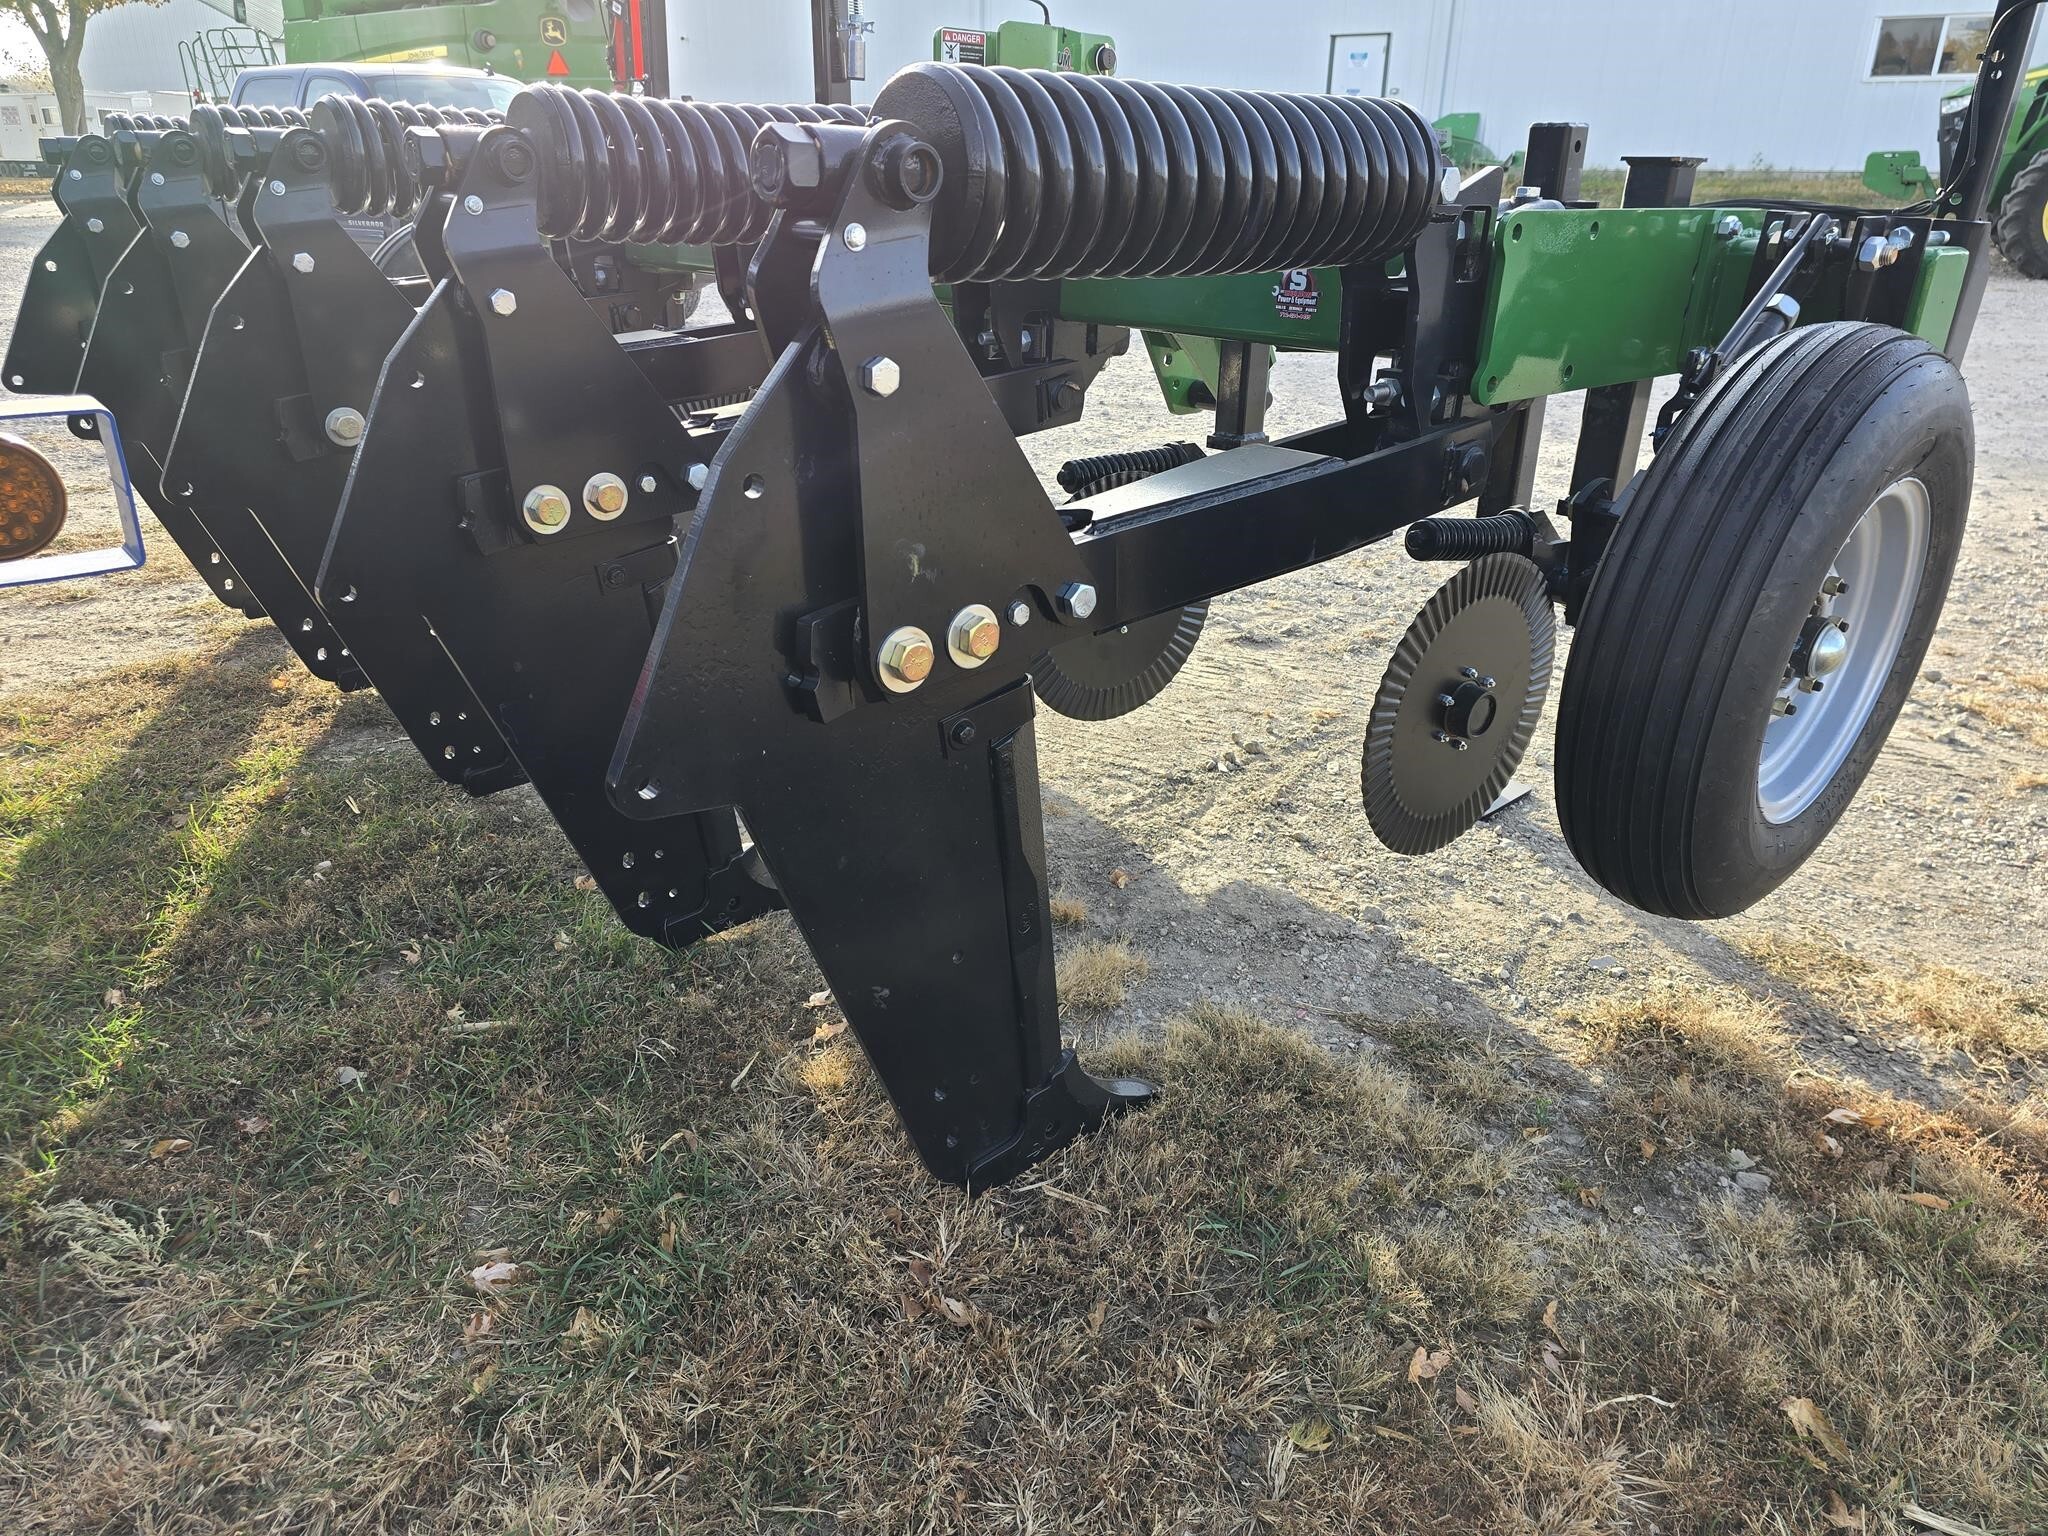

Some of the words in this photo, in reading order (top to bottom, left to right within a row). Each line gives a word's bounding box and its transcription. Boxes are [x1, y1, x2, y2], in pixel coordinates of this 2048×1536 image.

[952, 32, 982, 43] DANGER
[348, 219, 384, 227] SILVERADO
[1295, 296, 1317, 305] Equipment
